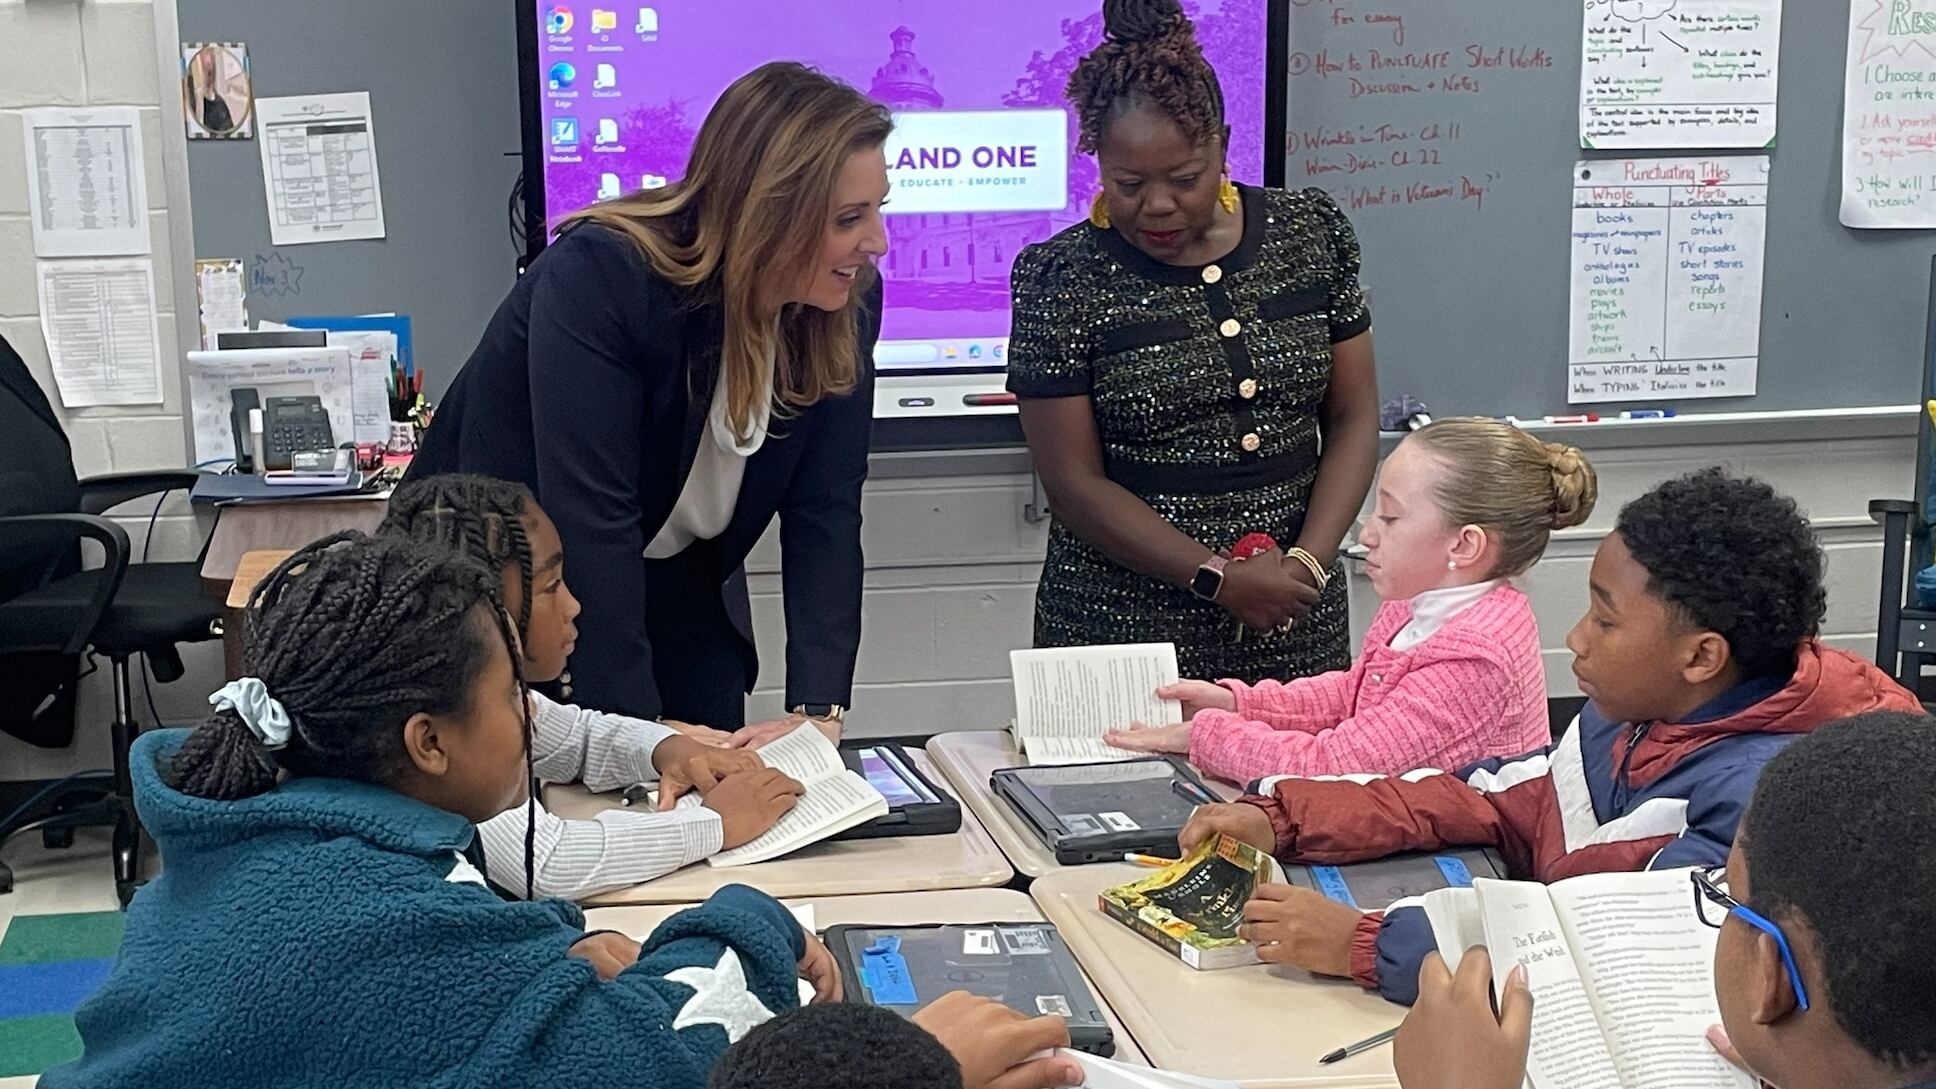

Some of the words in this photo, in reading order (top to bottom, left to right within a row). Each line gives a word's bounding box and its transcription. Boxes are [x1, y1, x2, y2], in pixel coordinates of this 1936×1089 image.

[1331, 8, 1355, 26] for
[1365, 14, 1405, 46] essay
[1620, 26, 1632, 34] the
[1316, 48, 1344, 79] How
[1346, 53, 1362, 71] to
[1466, 44, 1504, 68] Short
[1593, 76, 1610, 84] What
[1875, 64, 1922, 84] Choose
[1348, 75, 1420, 99] Discussion
[1442, 73, 1479, 92] Notes
[1874, 91, 1892, 102] are
[1589, 107, 1602, 116] The
[1604, 108, 1628, 116] central
[972, 146, 1037, 168] ONE
[1418, 149, 1442, 165] 22
[900, 178, 954, 188] EDUCATE
[968, 176, 1027, 186] EMPOWER
[1625, 161, 1695, 193] Punctuating
[1700, 161, 1730, 180] Titles
[1868, 174, 1890, 194] How
[1898, 176, 1922, 190] will
[1592, 186, 1634, 200] Whole
[1697, 186, 1727, 199] Parts
[1596, 210, 1634, 224] books
[1690, 209, 1734, 224] chapters
[1690, 226, 1722, 235] articles
[1592, 242, 1610, 255] TV
[1613, 245, 1638, 256] shows
[1678, 241, 1695, 254] TV
[1698, 244, 1736, 256] episodes
[1680, 260, 1707, 269] short
[1714, 260, 1744, 269] stories
[281, 270, 288, 285] 3
[1593, 274, 1630, 284] albums
[1692, 273, 1720, 286] songs
[1590, 288, 1624, 296] movies
[1691, 284, 1725, 299] reports
[1591, 300, 1616, 312] plays
[1688, 301, 1726, 314] essays
[1588, 311, 1628, 320] artwork
[1574, 367, 1596, 376] When
[1602, 366, 1648, 376] WRITING
[1655, 364, 1690, 374] Underline
[1696, 364, 1708, 372] the
[1574, 382, 1594, 394] When
[1601, 382, 1640, 393] TYPING
[1650, 380, 1688, 391] Italicize
[1512, 936, 1528, 948] The
